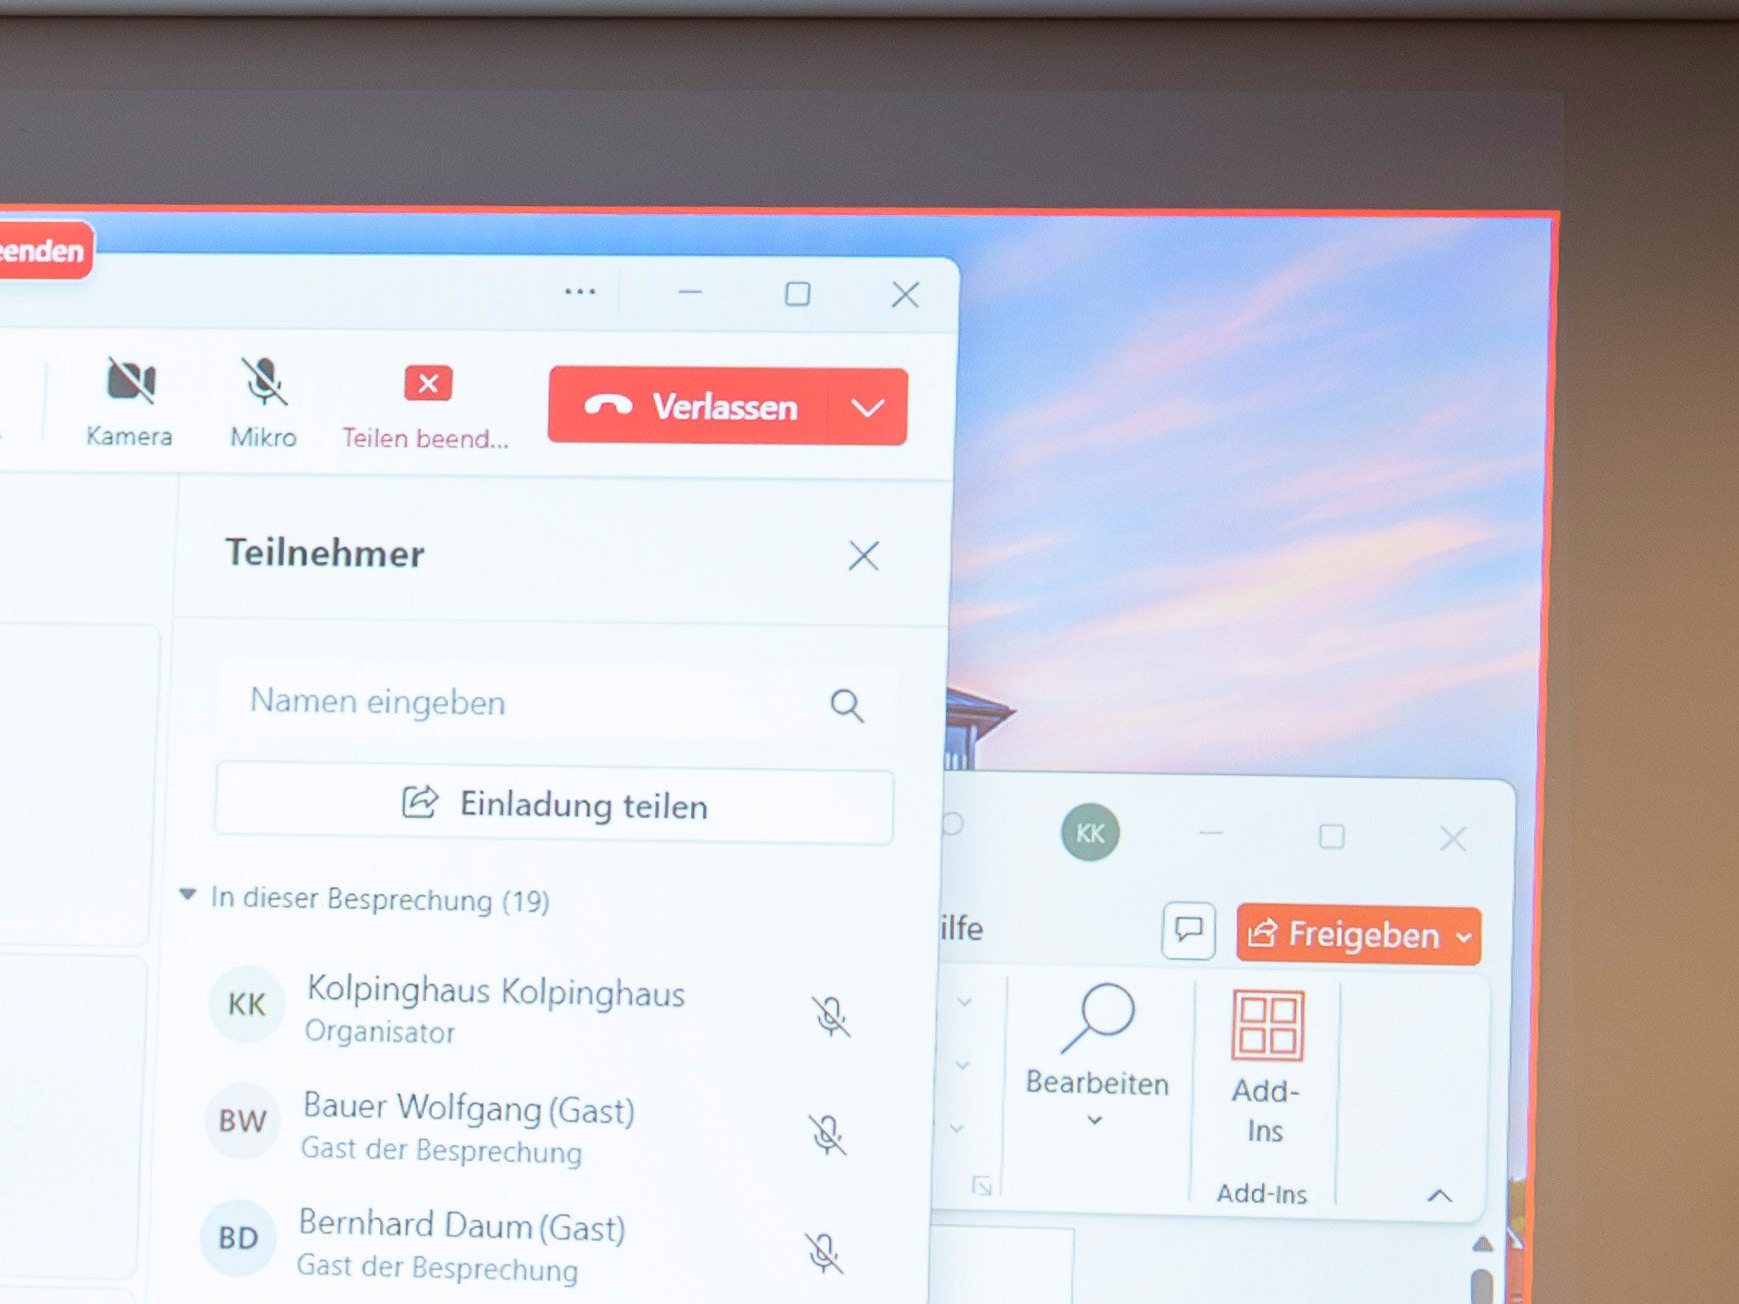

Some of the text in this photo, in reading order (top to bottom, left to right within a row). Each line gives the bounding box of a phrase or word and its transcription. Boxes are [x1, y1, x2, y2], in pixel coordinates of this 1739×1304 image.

[653, 394, 798, 421] Verlassen
[87, 426, 172, 447] Kamera
[231, 427, 297, 448] Mikro
[343, 427, 509, 450] Teilen beend...
[225, 538, 425, 568] Teilnehmer
[250, 687, 506, 722] Namen eingeben
[461, 792, 708, 825] Einladung teilen
[212, 886, 550, 916] In dieser Besprechung (19)
[1290, 921, 1440, 954] Freigeben
[308, 974, 685, 1014] Kolpinghaus Kolpinghaus
[305, 1019, 455, 1047] Organisator
[1026, 1070, 1169, 1095] Bearbeiten
[1232, 1080, 1300, 1103] Add-
[304, 1091, 635, 1129] Bauer Wolfgang (Gast)
[1248, 1121, 1283, 1143] Ins
[302, 1137, 582, 1169] Gast der Besprechung
[1217, 1184, 1308, 1205] Add-Ins
[300, 1209, 625, 1247] Bernhard Daum (Gast)
